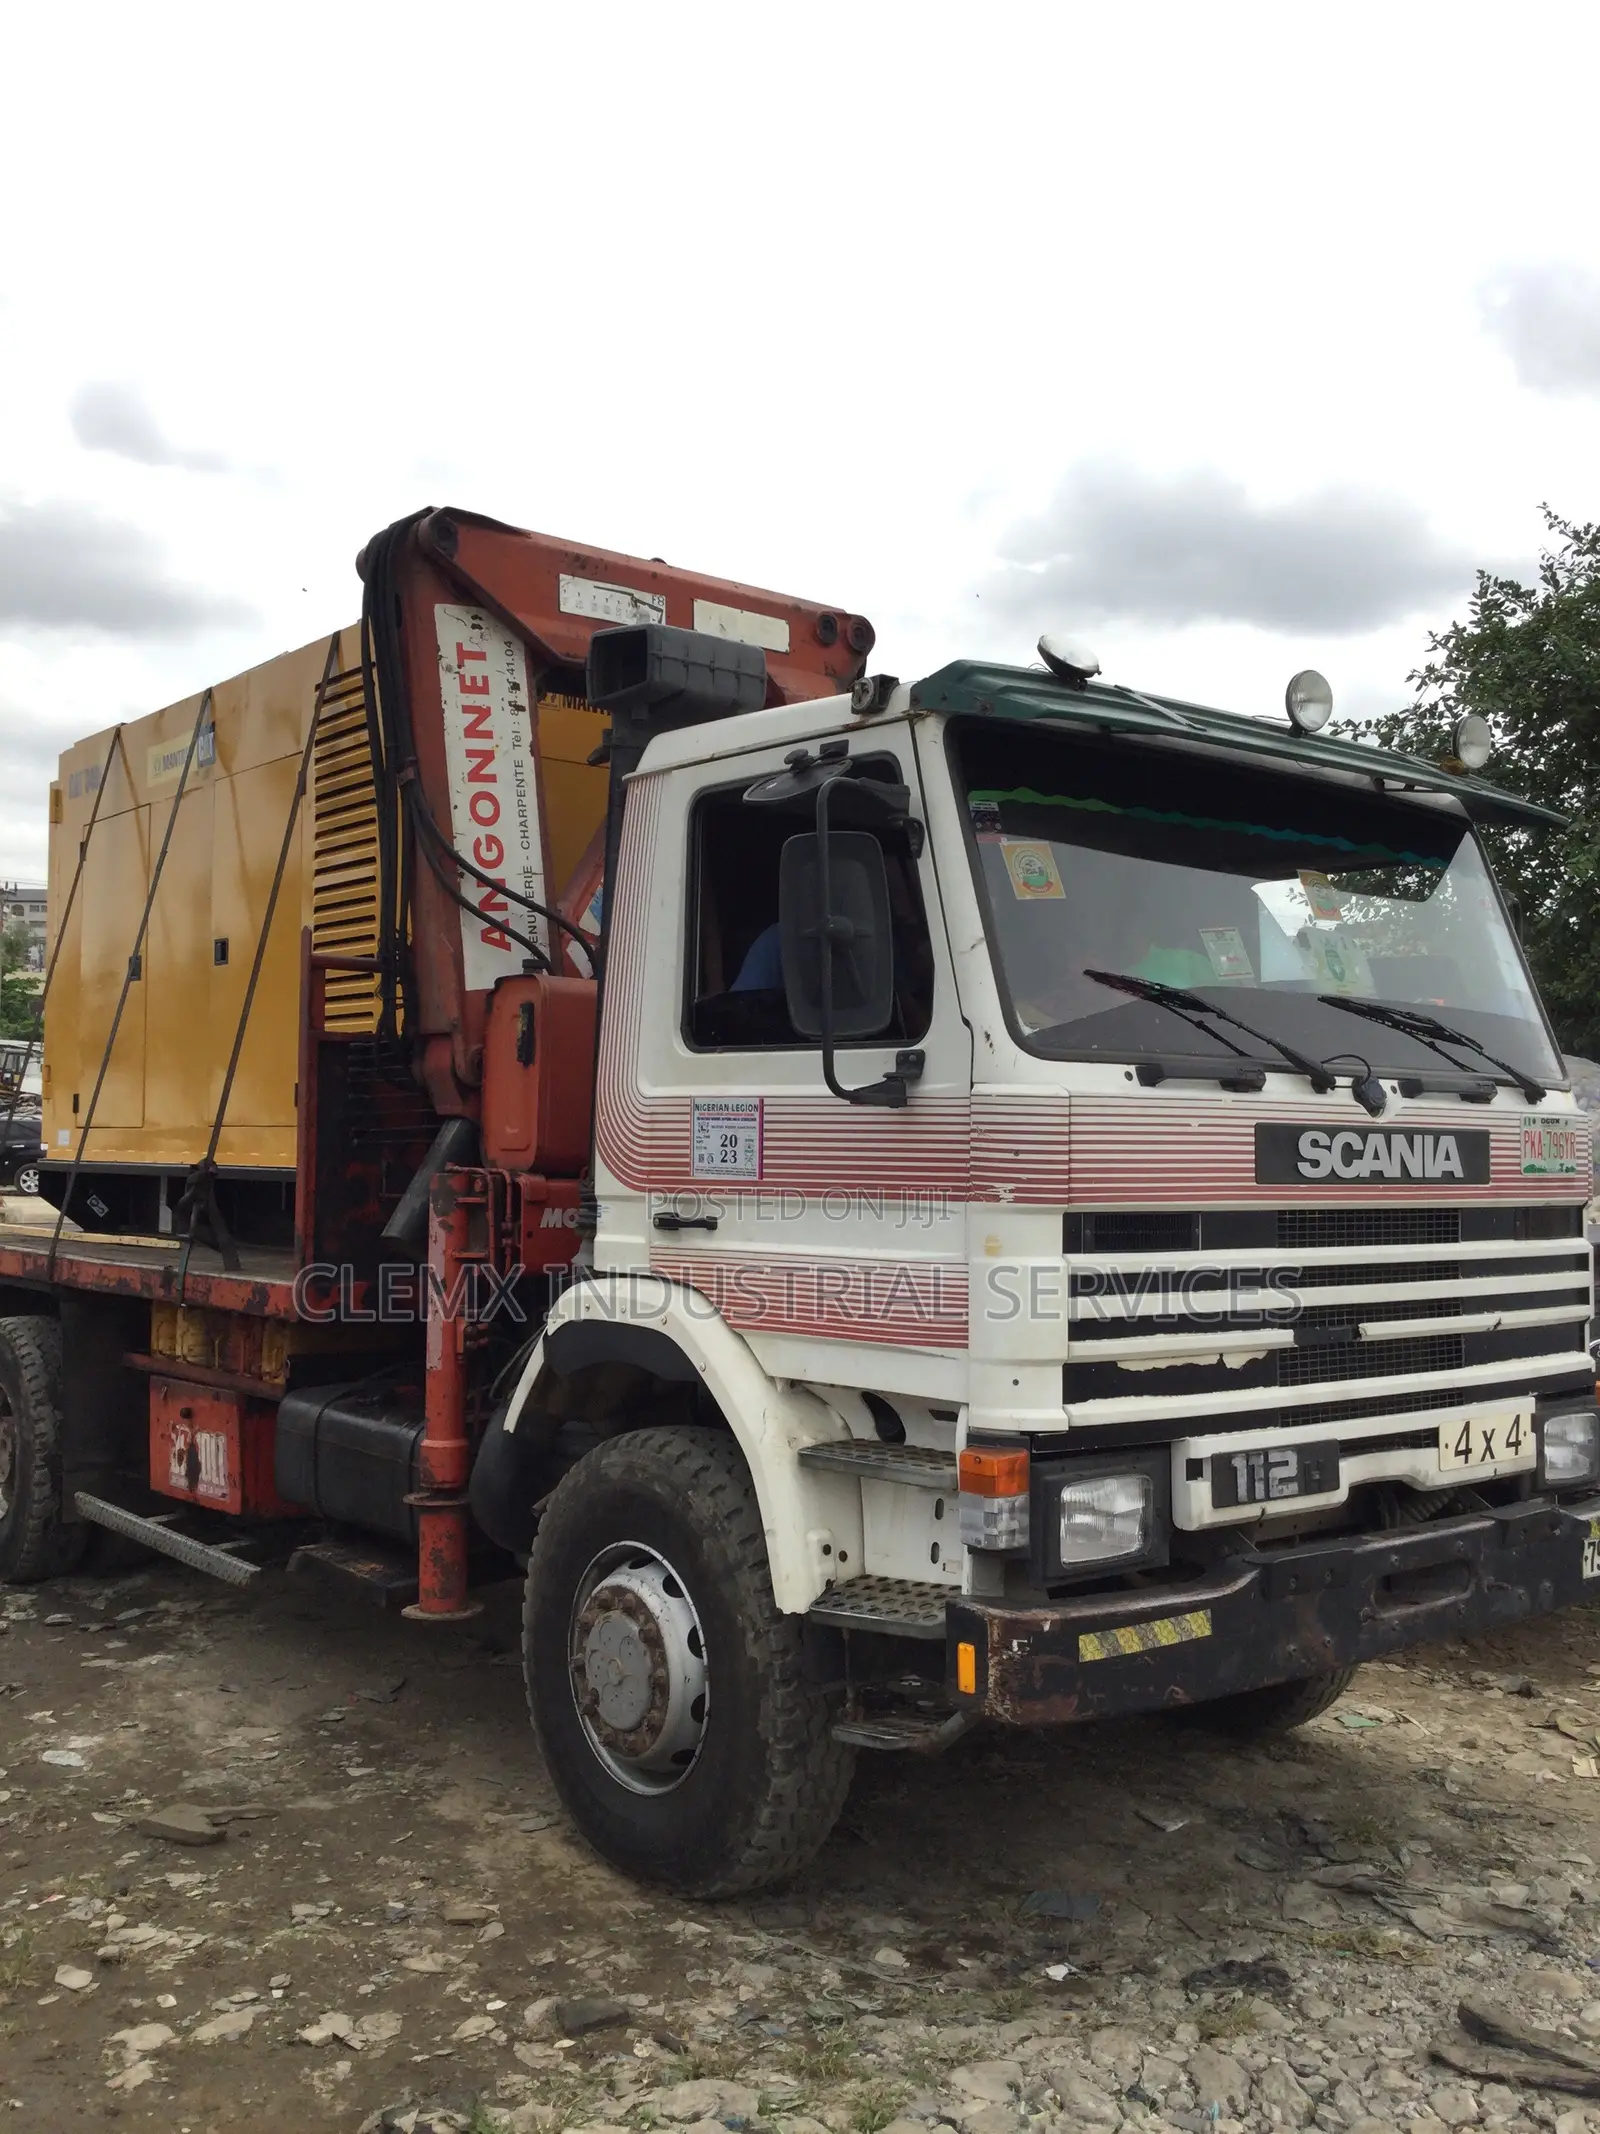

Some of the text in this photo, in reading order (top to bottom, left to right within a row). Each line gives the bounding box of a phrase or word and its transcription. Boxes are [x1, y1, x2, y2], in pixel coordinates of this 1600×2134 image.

[456, 642, 511, 951] ANGONNET
[514, 759, 531, 851] CHARPENTE
[694, 1103, 759, 1112] NIGERIAN LEGION
[1541, 1117, 1561, 1125] OGUN
[720, 1133, 738, 1149] 20
[720, 1149, 738, 1164] 23
[1297, 1130, 1465, 1179] SCANIA
